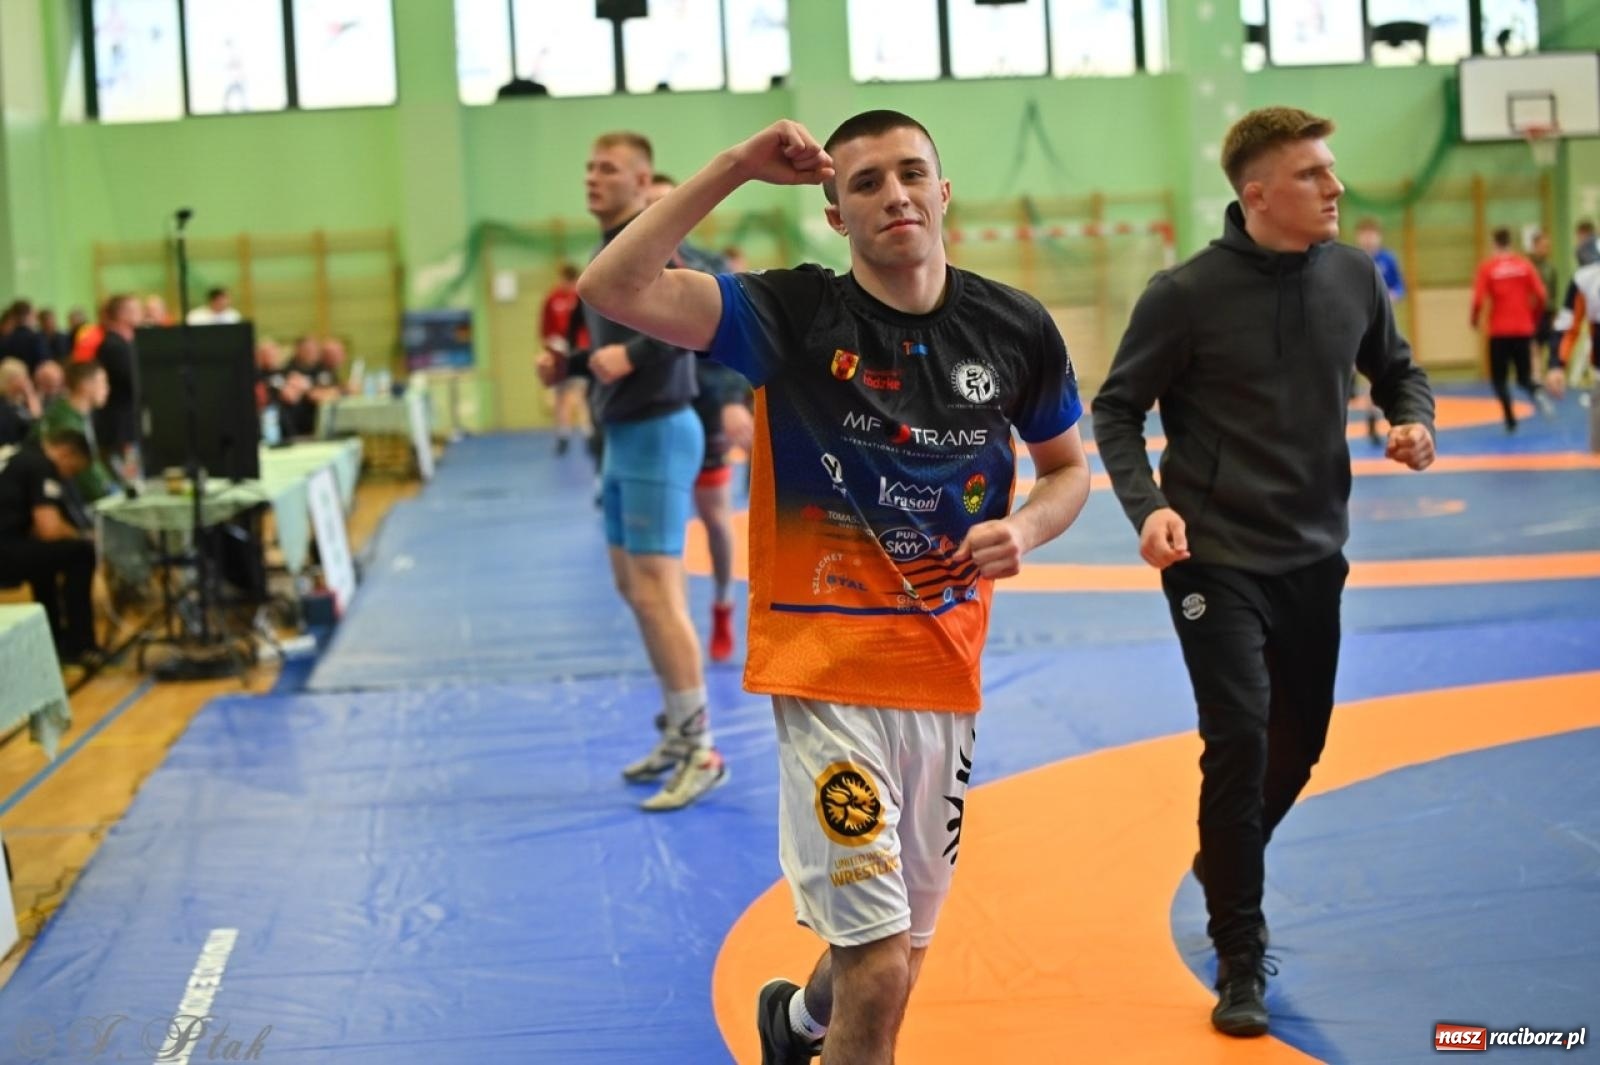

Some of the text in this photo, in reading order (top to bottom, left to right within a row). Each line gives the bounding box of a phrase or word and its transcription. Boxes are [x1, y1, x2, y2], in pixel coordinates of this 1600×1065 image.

[842, 411, 988, 446] MF TRANS
[895, 530, 918, 540] PUB
[885, 540, 923, 555] SKYY
